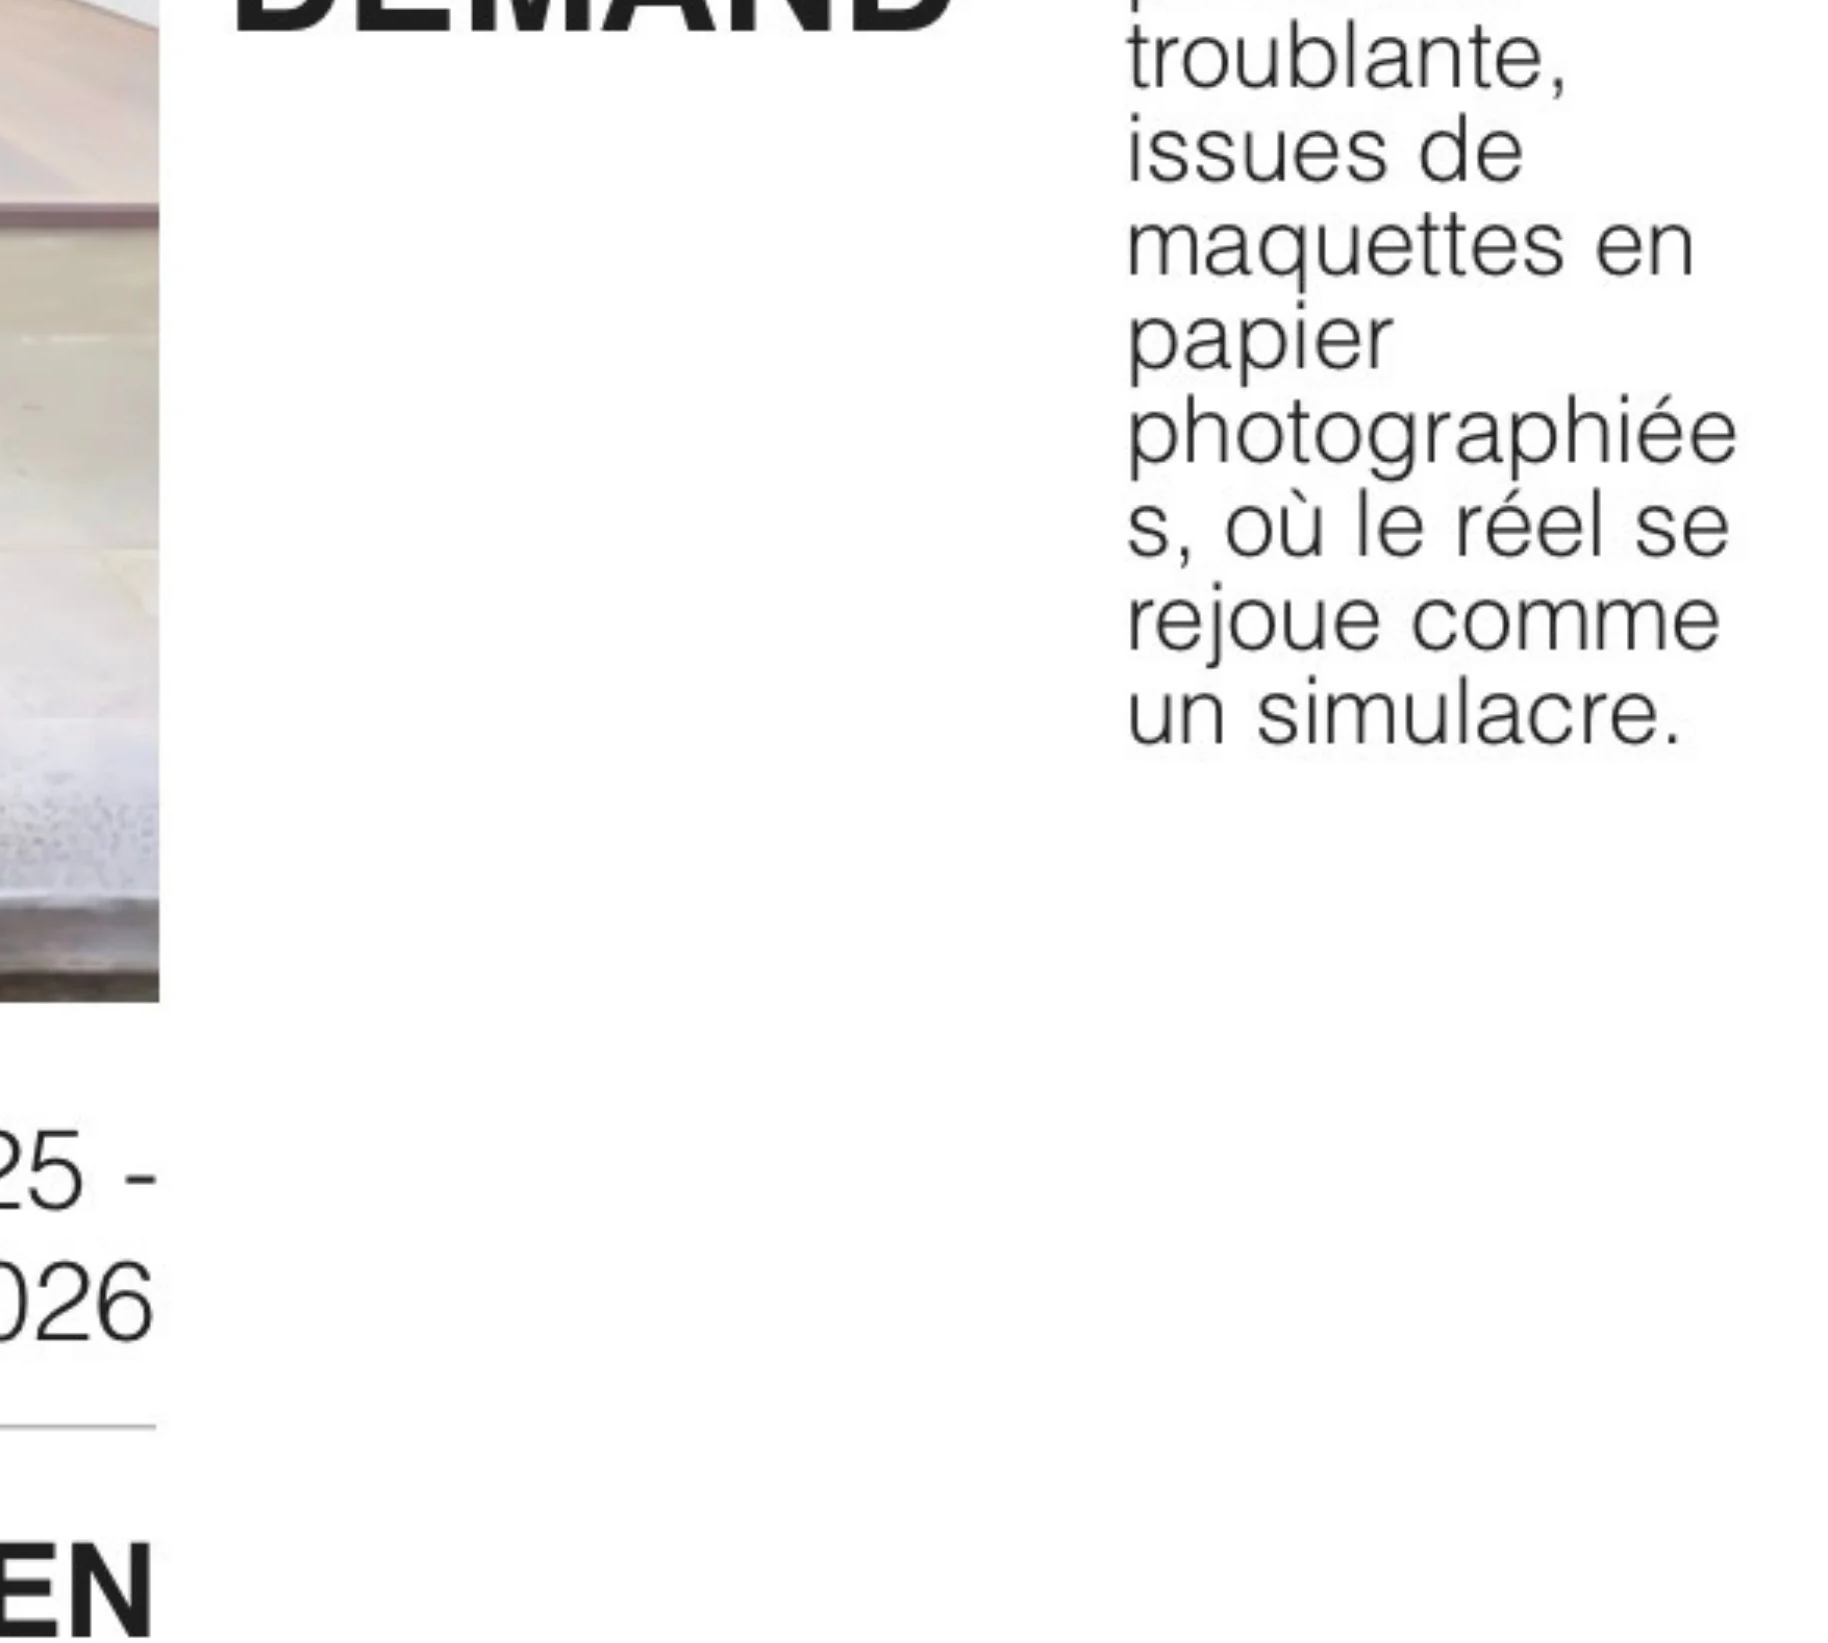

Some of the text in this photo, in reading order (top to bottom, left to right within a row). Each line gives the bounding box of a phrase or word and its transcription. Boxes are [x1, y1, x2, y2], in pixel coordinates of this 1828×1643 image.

[1125, 18, 1563, 100] troublante,
[1130, 112, 1522, 184] issues de
[1130, 211, 1692, 295] maquettes en
[1130, 299, 1394, 388] papier
[1130, 393, 1737, 484] photographiée
[1128, 486, 1729, 569] s, où le réel se
[1130, 580, 1719, 669] rejoue comme
[1130, 674, 1678, 746] un simulacre.
